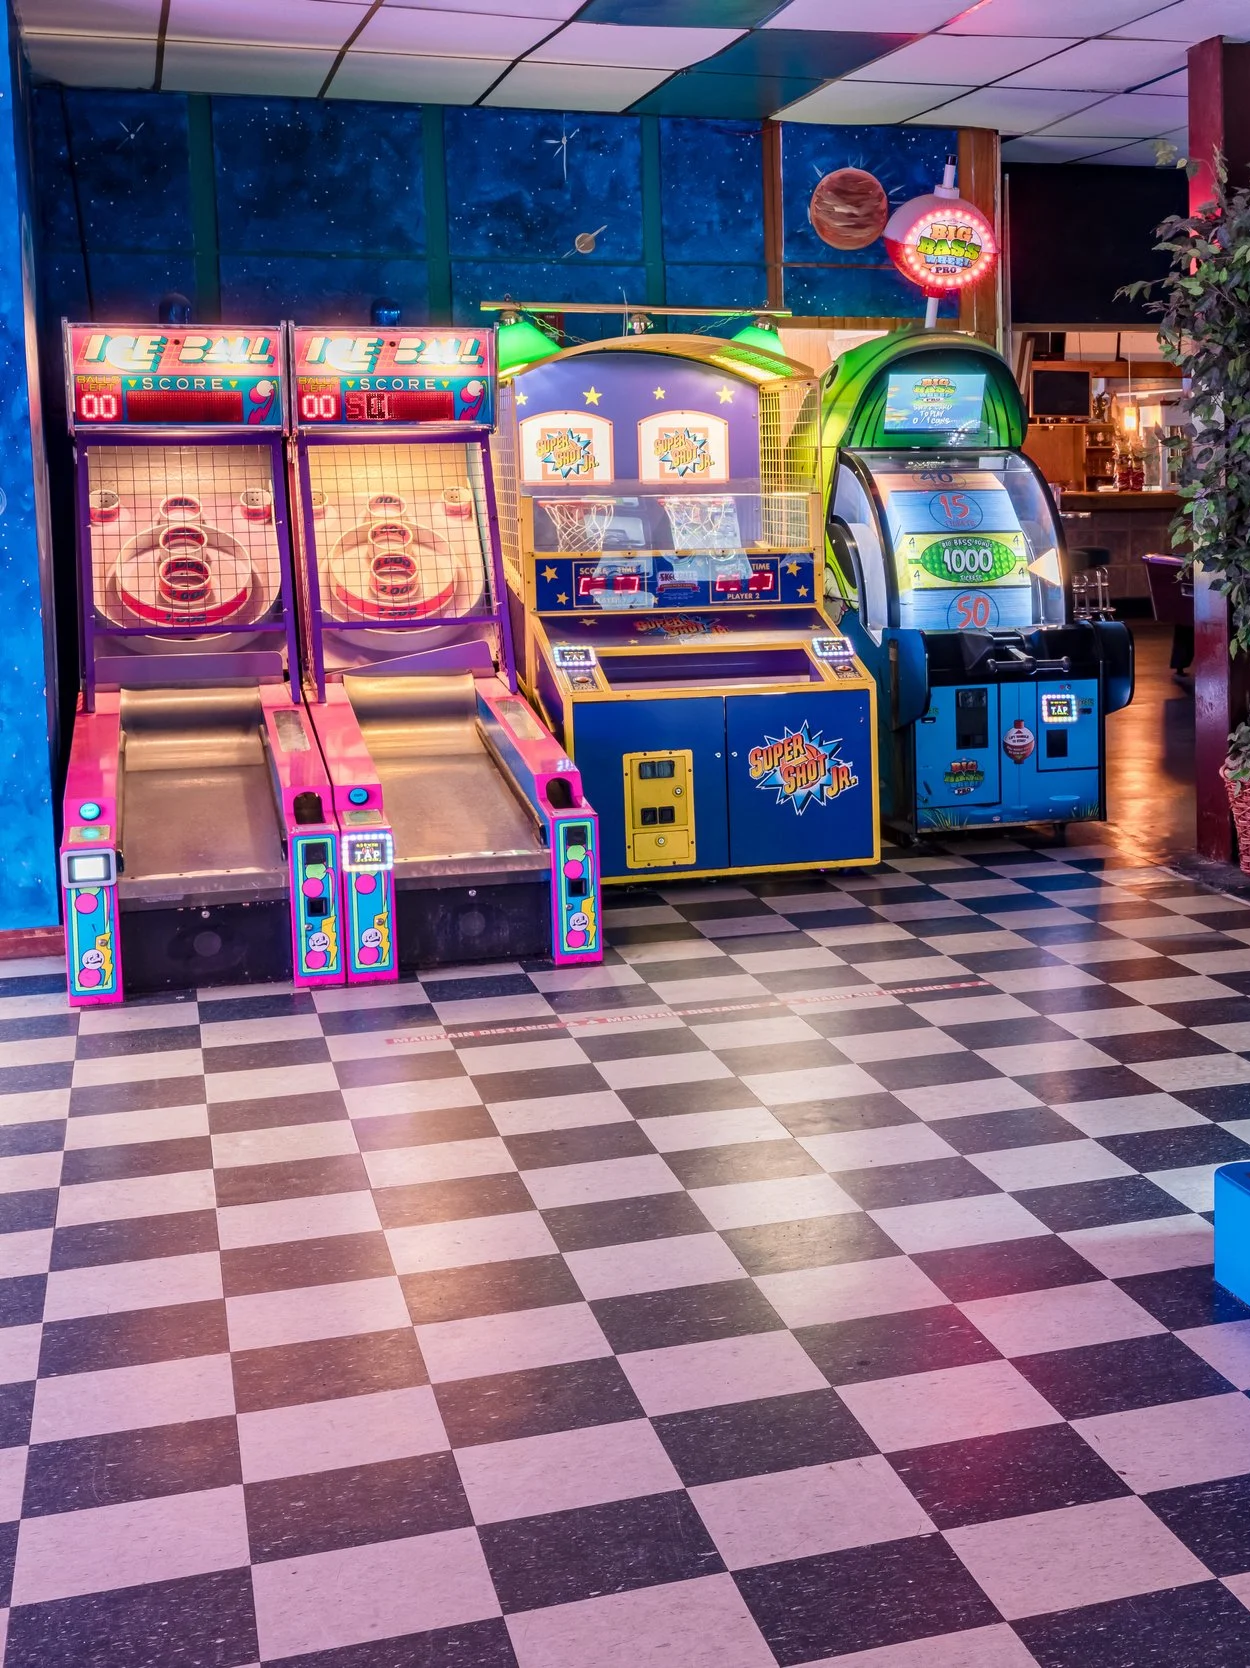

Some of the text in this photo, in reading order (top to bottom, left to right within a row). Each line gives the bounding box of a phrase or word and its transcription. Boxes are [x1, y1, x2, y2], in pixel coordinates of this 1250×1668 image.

[930, 223, 973, 242] BIG
[917, 236, 981, 260] BASS
[84, 334, 275, 373] ICE BALL
[305, 337, 485, 374] ICE BALL
[81, 384, 115, 392] LEFT
[142, 378, 224, 390] SCORE
[302, 384, 335, 392] LEFT
[360, 378, 436, 390] SCORE
[81, 394, 117, 418] 00
[302, 395, 335, 418] 00
[536, 433, 570, 457] SUPER
[654, 433, 687, 457] SUPER
[554, 446, 583, 469] SHOT
[581, 453, 600, 472] JR.
[672, 446, 698, 469] SHOT
[698, 453, 715, 472] JR.
[940, 494, 970, 518] 15
[909, 537, 916, 546] 4
[954, 538, 972, 546] BASS
[1013, 535, 1019, 545] 4
[943, 549, 993, 573] 1000
[914, 570, 921, 581] 4
[1018, 567, 1025, 577] 4
[755, 592, 760, 600] 2
[957, 595, 990, 629] 50
[635, 616, 682, 631] SUPER
[1051, 706, 1068, 714] TAP
[749, 733, 806, 779] SUPER
[783, 753, 828, 795] SHOT
[951, 761, 977, 772] BIG
[826, 765, 858, 799] JR.
[957, 787, 972, 795] PRO
[355, 848, 380, 861] TAP
[393, 1031, 475, 1045] MAINTAIN
[479, 1023, 560, 1036] DISTANCE
[605, 1010, 684, 1024] MAINTAIN
[687, 1002, 760, 1015] DISTANCE
[885, 983, 952, 996] DISTANCE
